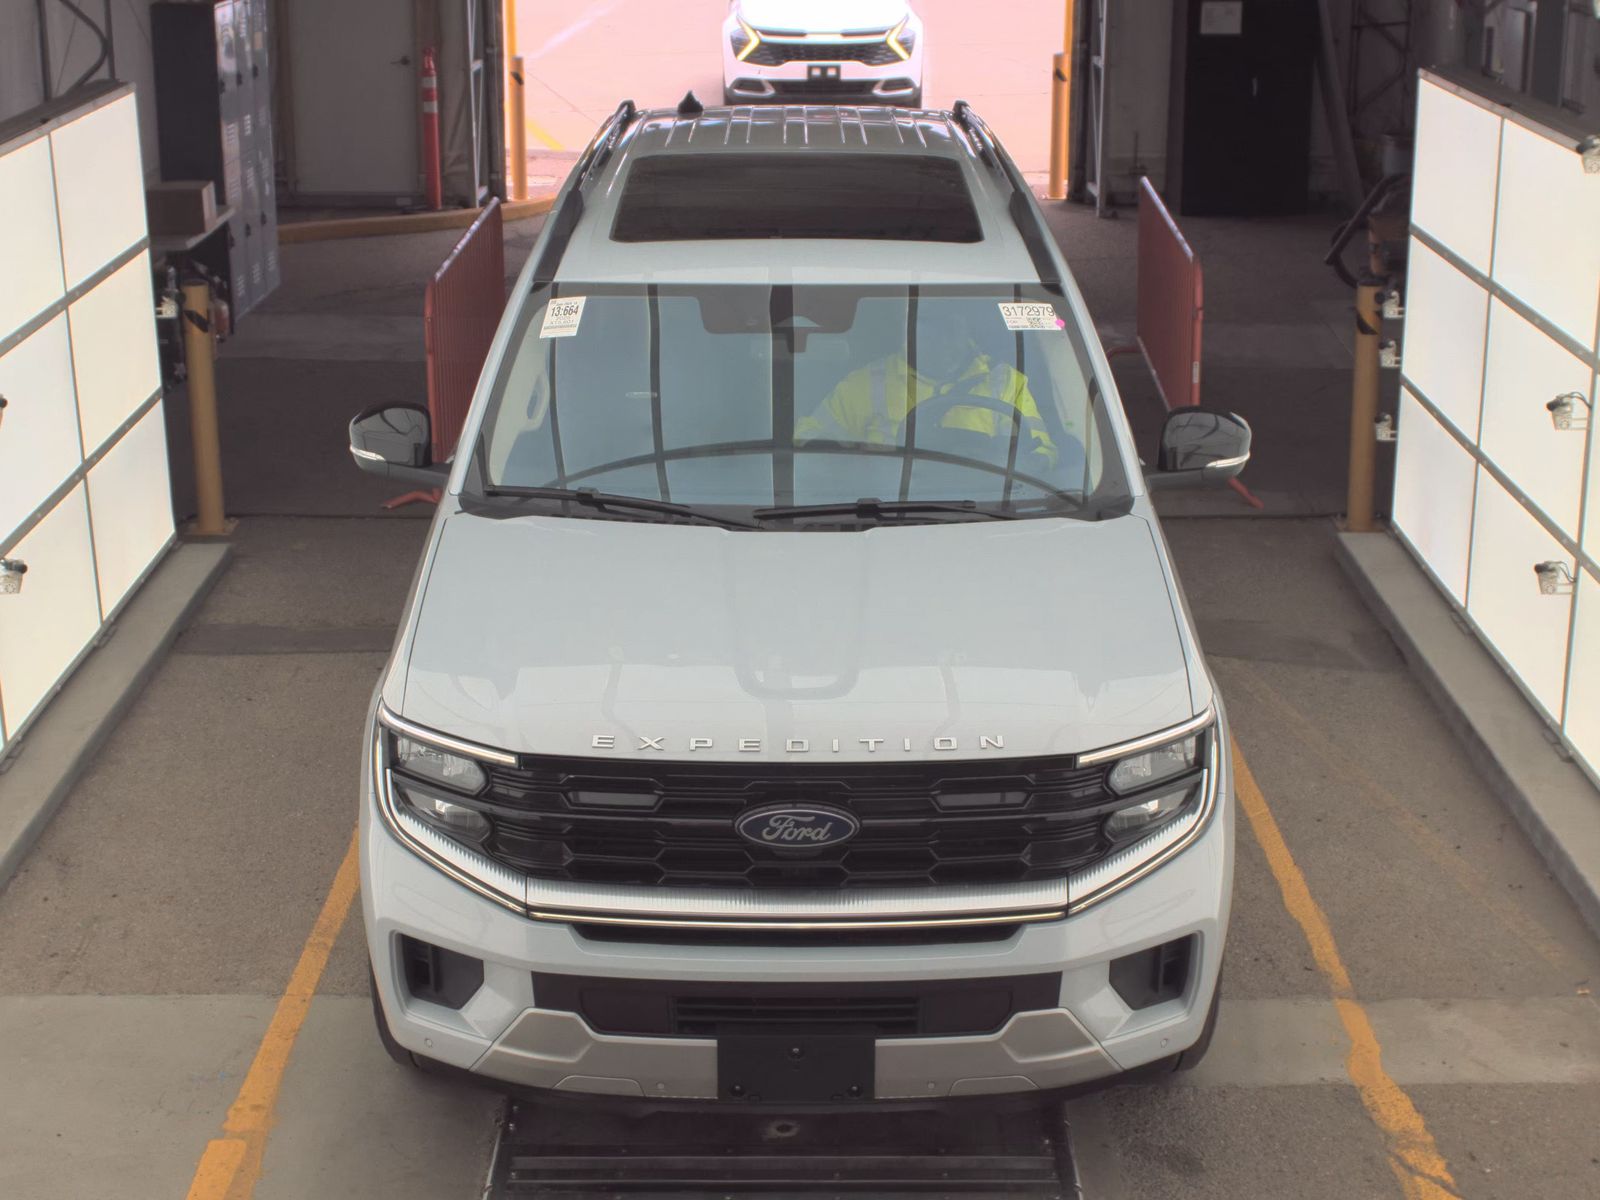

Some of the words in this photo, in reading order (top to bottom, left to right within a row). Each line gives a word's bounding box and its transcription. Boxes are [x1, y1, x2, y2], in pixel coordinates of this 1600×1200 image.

[1002, 305, 1055, 317] 3172979
[591, 734, 1005, 752] EXPEDITION
[762, 814, 831, 841] Ford
